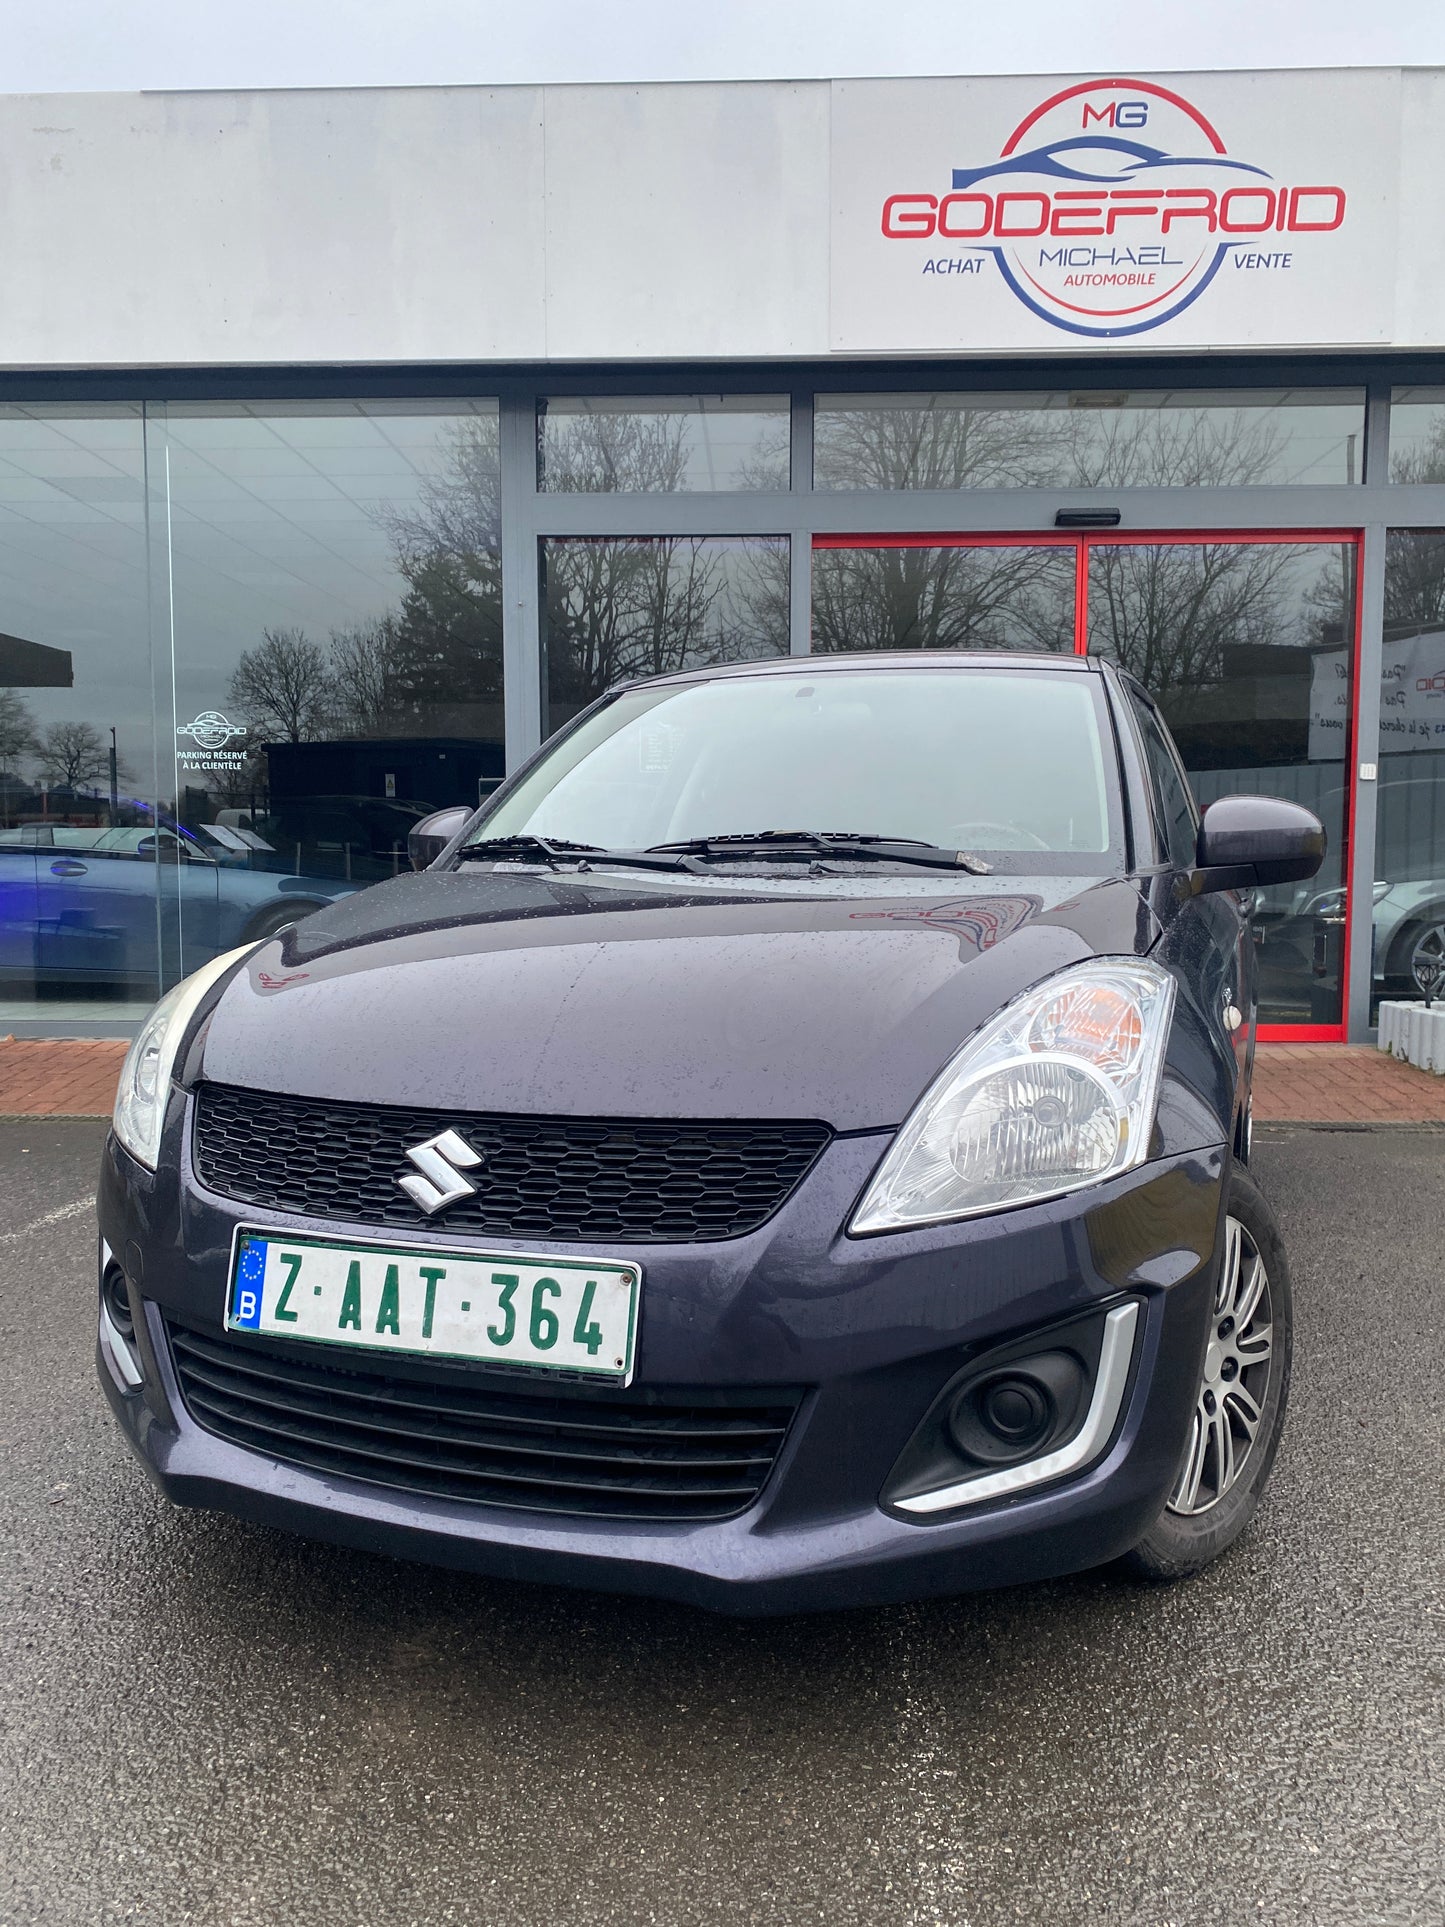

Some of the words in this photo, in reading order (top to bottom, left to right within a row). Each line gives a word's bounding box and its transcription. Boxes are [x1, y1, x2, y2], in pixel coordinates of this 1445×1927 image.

[1082, 102, 1149, 128] MG
[881, 186, 1347, 239] GODEFROID
[1039, 246, 1183, 268] MICHAEL
[1234, 252, 1293, 270] VENTE
[922, 258, 985, 275] ACHAT
[1063, 272, 1156, 287] AUTOMOBILE
[177, 727, 246, 735] GODEFROID
[213, 750, 247, 759] RÉSERVÉ
[183, 760, 188, 769] À
[202, 760, 241, 769] CLIENTÈLE
[240, 1291, 257, 1319] B
